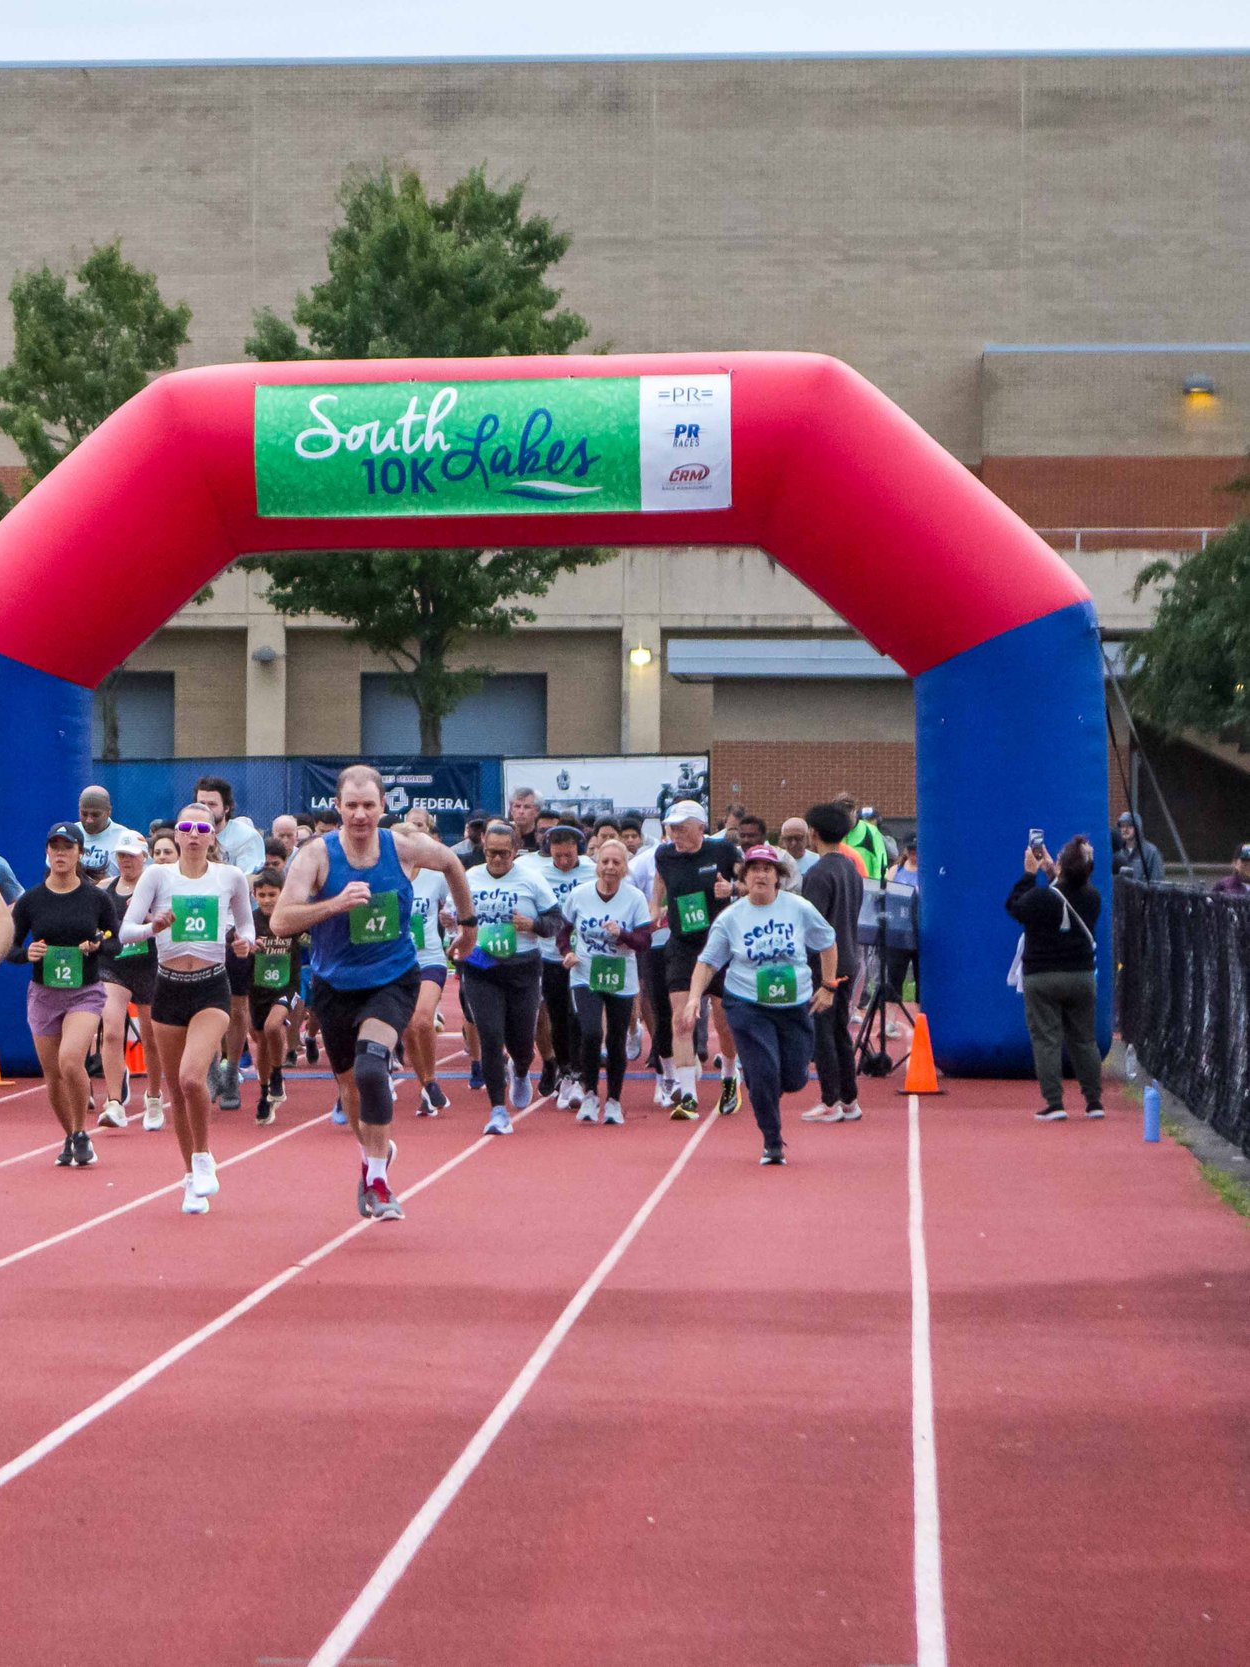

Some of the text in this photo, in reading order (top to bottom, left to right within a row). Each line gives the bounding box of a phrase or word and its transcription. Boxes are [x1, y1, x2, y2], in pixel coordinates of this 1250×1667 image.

[295, 386, 459, 459] South
[674, 423, 700, 439] PR
[441, 407, 601, 489] Lakes
[673, 439, 700, 448] RACES
[361, 454, 437, 495] 10K
[669, 469, 705, 482] CRM
[413, 798, 470, 810] FEDERAL
[185, 917, 206, 932] 20
[365, 916, 387, 932] 47
[743, 919, 795, 946] SOUTH
[487, 939, 510, 952] 111
[54, 966, 71, 980] 12
[264, 969, 280, 981] 36
[597, 973, 619, 985] 113
[768, 985, 785, 998] 34
